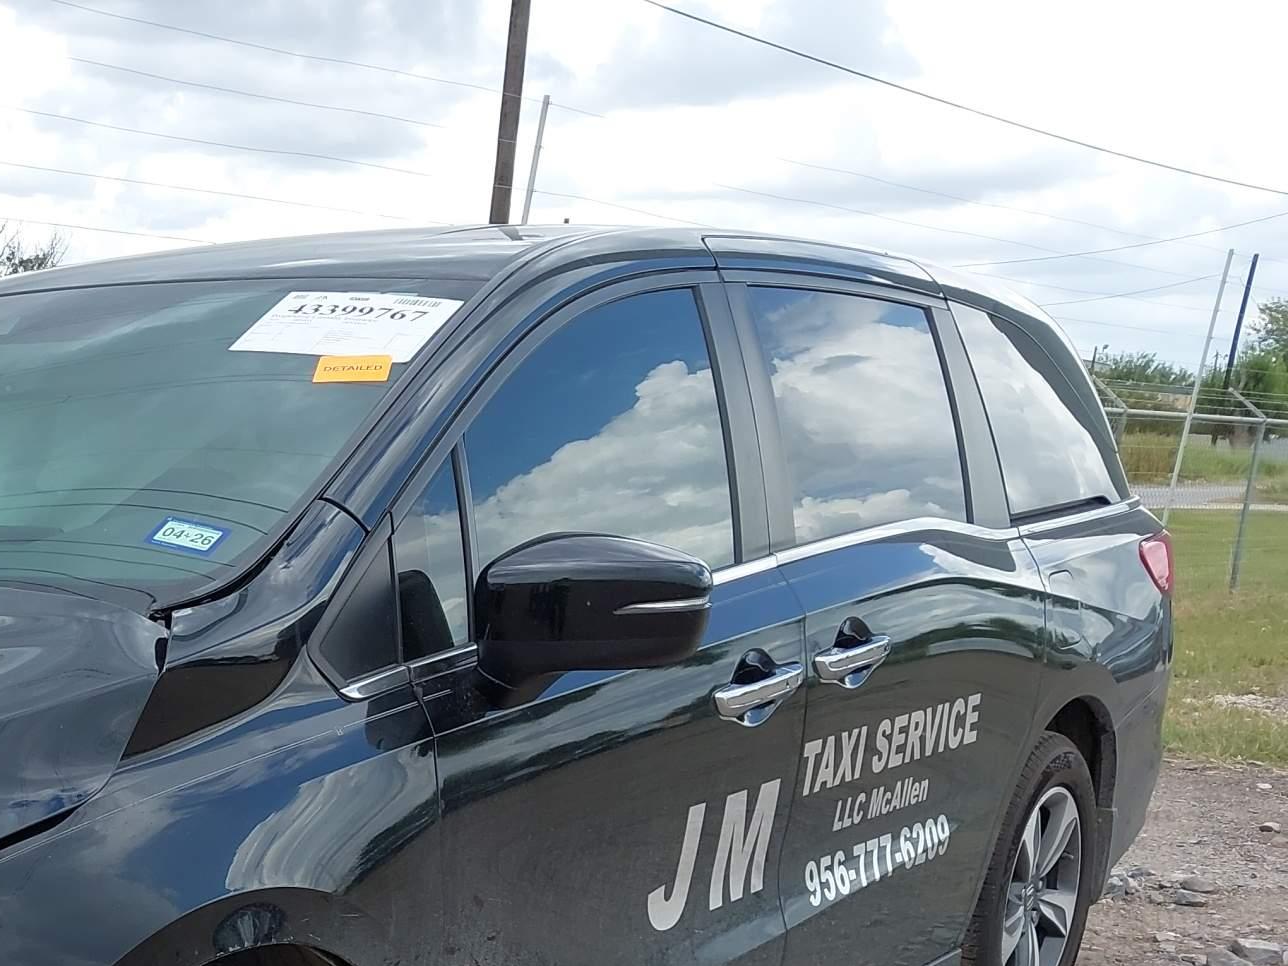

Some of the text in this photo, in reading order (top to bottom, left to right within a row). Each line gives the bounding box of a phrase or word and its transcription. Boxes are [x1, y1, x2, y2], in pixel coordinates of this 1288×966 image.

[287, 302, 430, 323] 43399767
[323, 364, 383, 373] DETAILED
[802, 693, 982, 797] TAXI SERVICE
[832, 776, 929, 832] LLC McAllen
[805, 814, 952, 907] 956-777-6209
